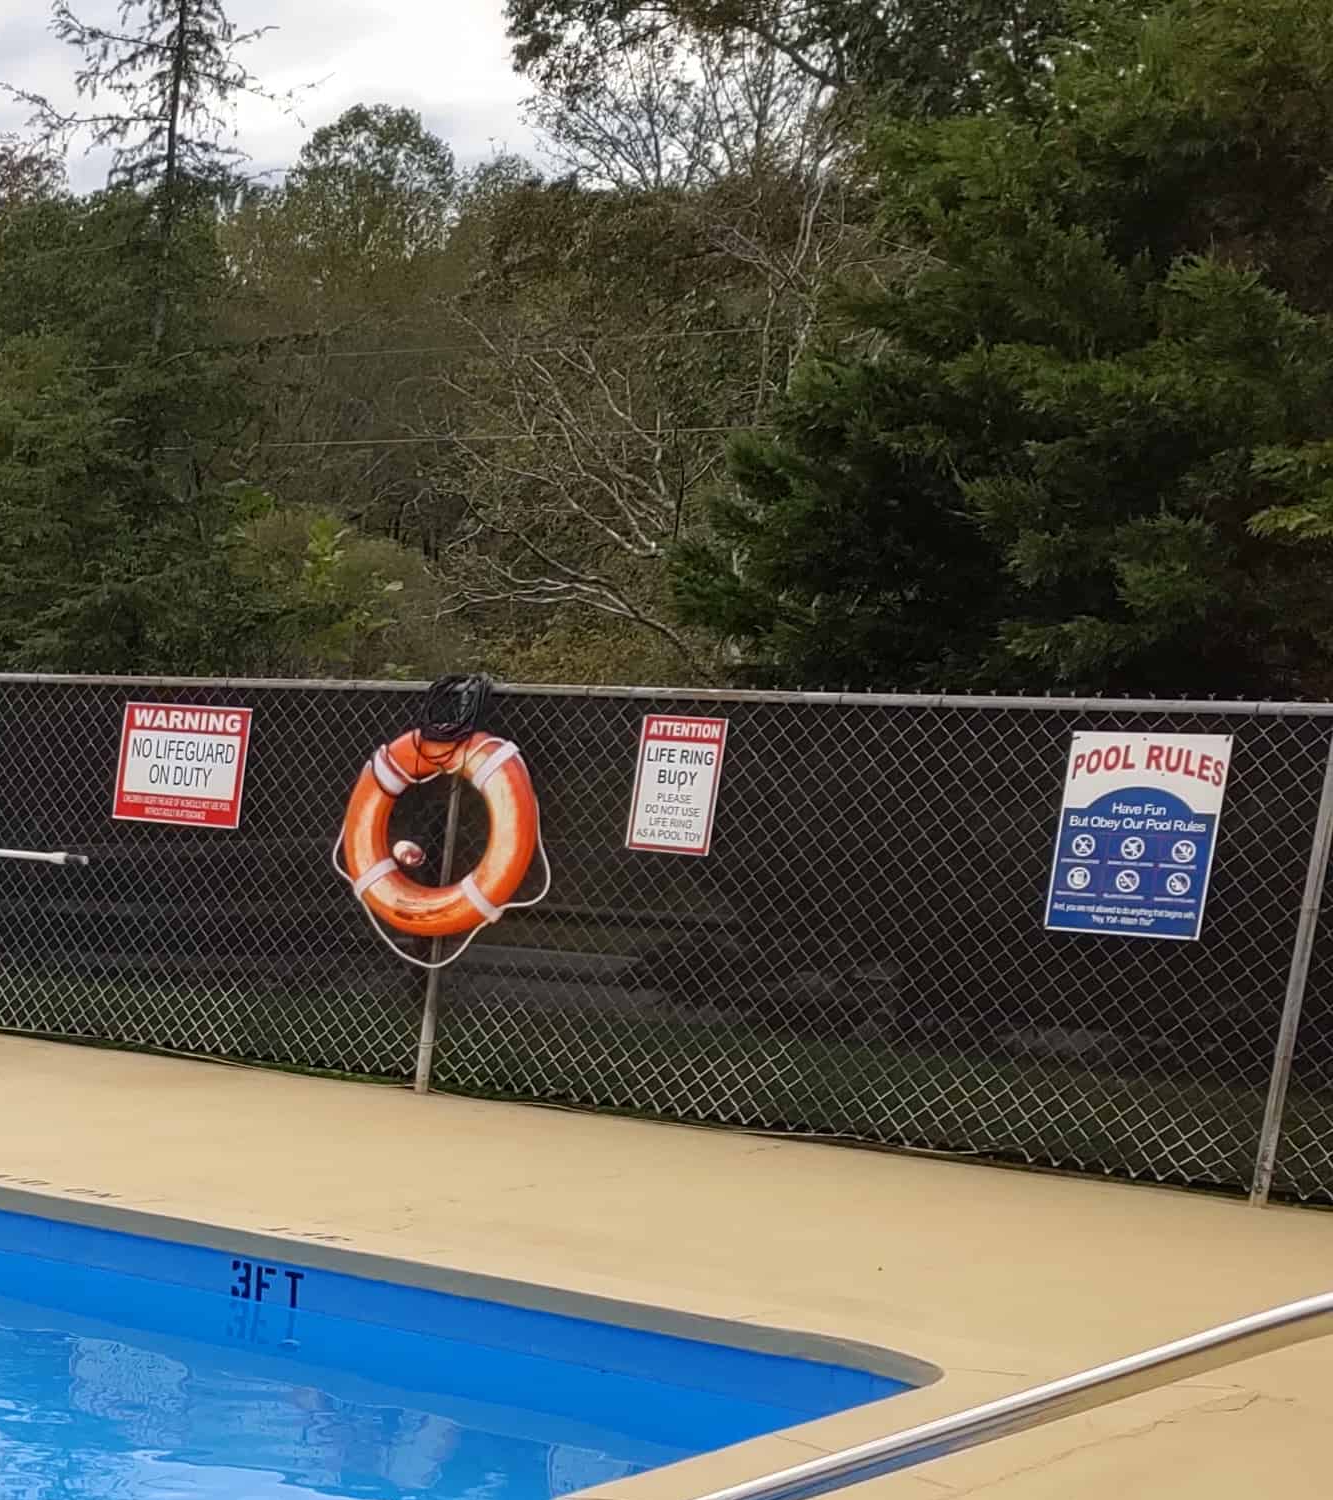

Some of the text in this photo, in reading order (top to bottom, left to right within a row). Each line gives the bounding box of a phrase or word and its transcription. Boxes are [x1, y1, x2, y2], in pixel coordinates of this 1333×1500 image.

[134, 708, 242, 733] WARNING
[649, 721, 722, 739] ATTENTION
[132, 737, 235, 765] NO LIFEGUARD
[646, 747, 715, 766] LIFE RING
[1072, 744, 1225, 787] POOL RULES
[149, 764, 213, 788] ON DUTY
[657, 769, 698, 787] BUOY
[657, 792, 693, 804] PLEASE
[645, 803, 701, 818] DO NOT USE
[1111, 802, 1167, 816] Have Fun
[649, 817, 693, 829] LIFE RING
[1069, 815, 1207, 832] But Obey Our Pool Rules
[636, 828, 648, 838] AS
[649, 829, 656, 839] A
[658, 830, 683, 841] POOL
[231, 1260, 305, 1309] 3FT
